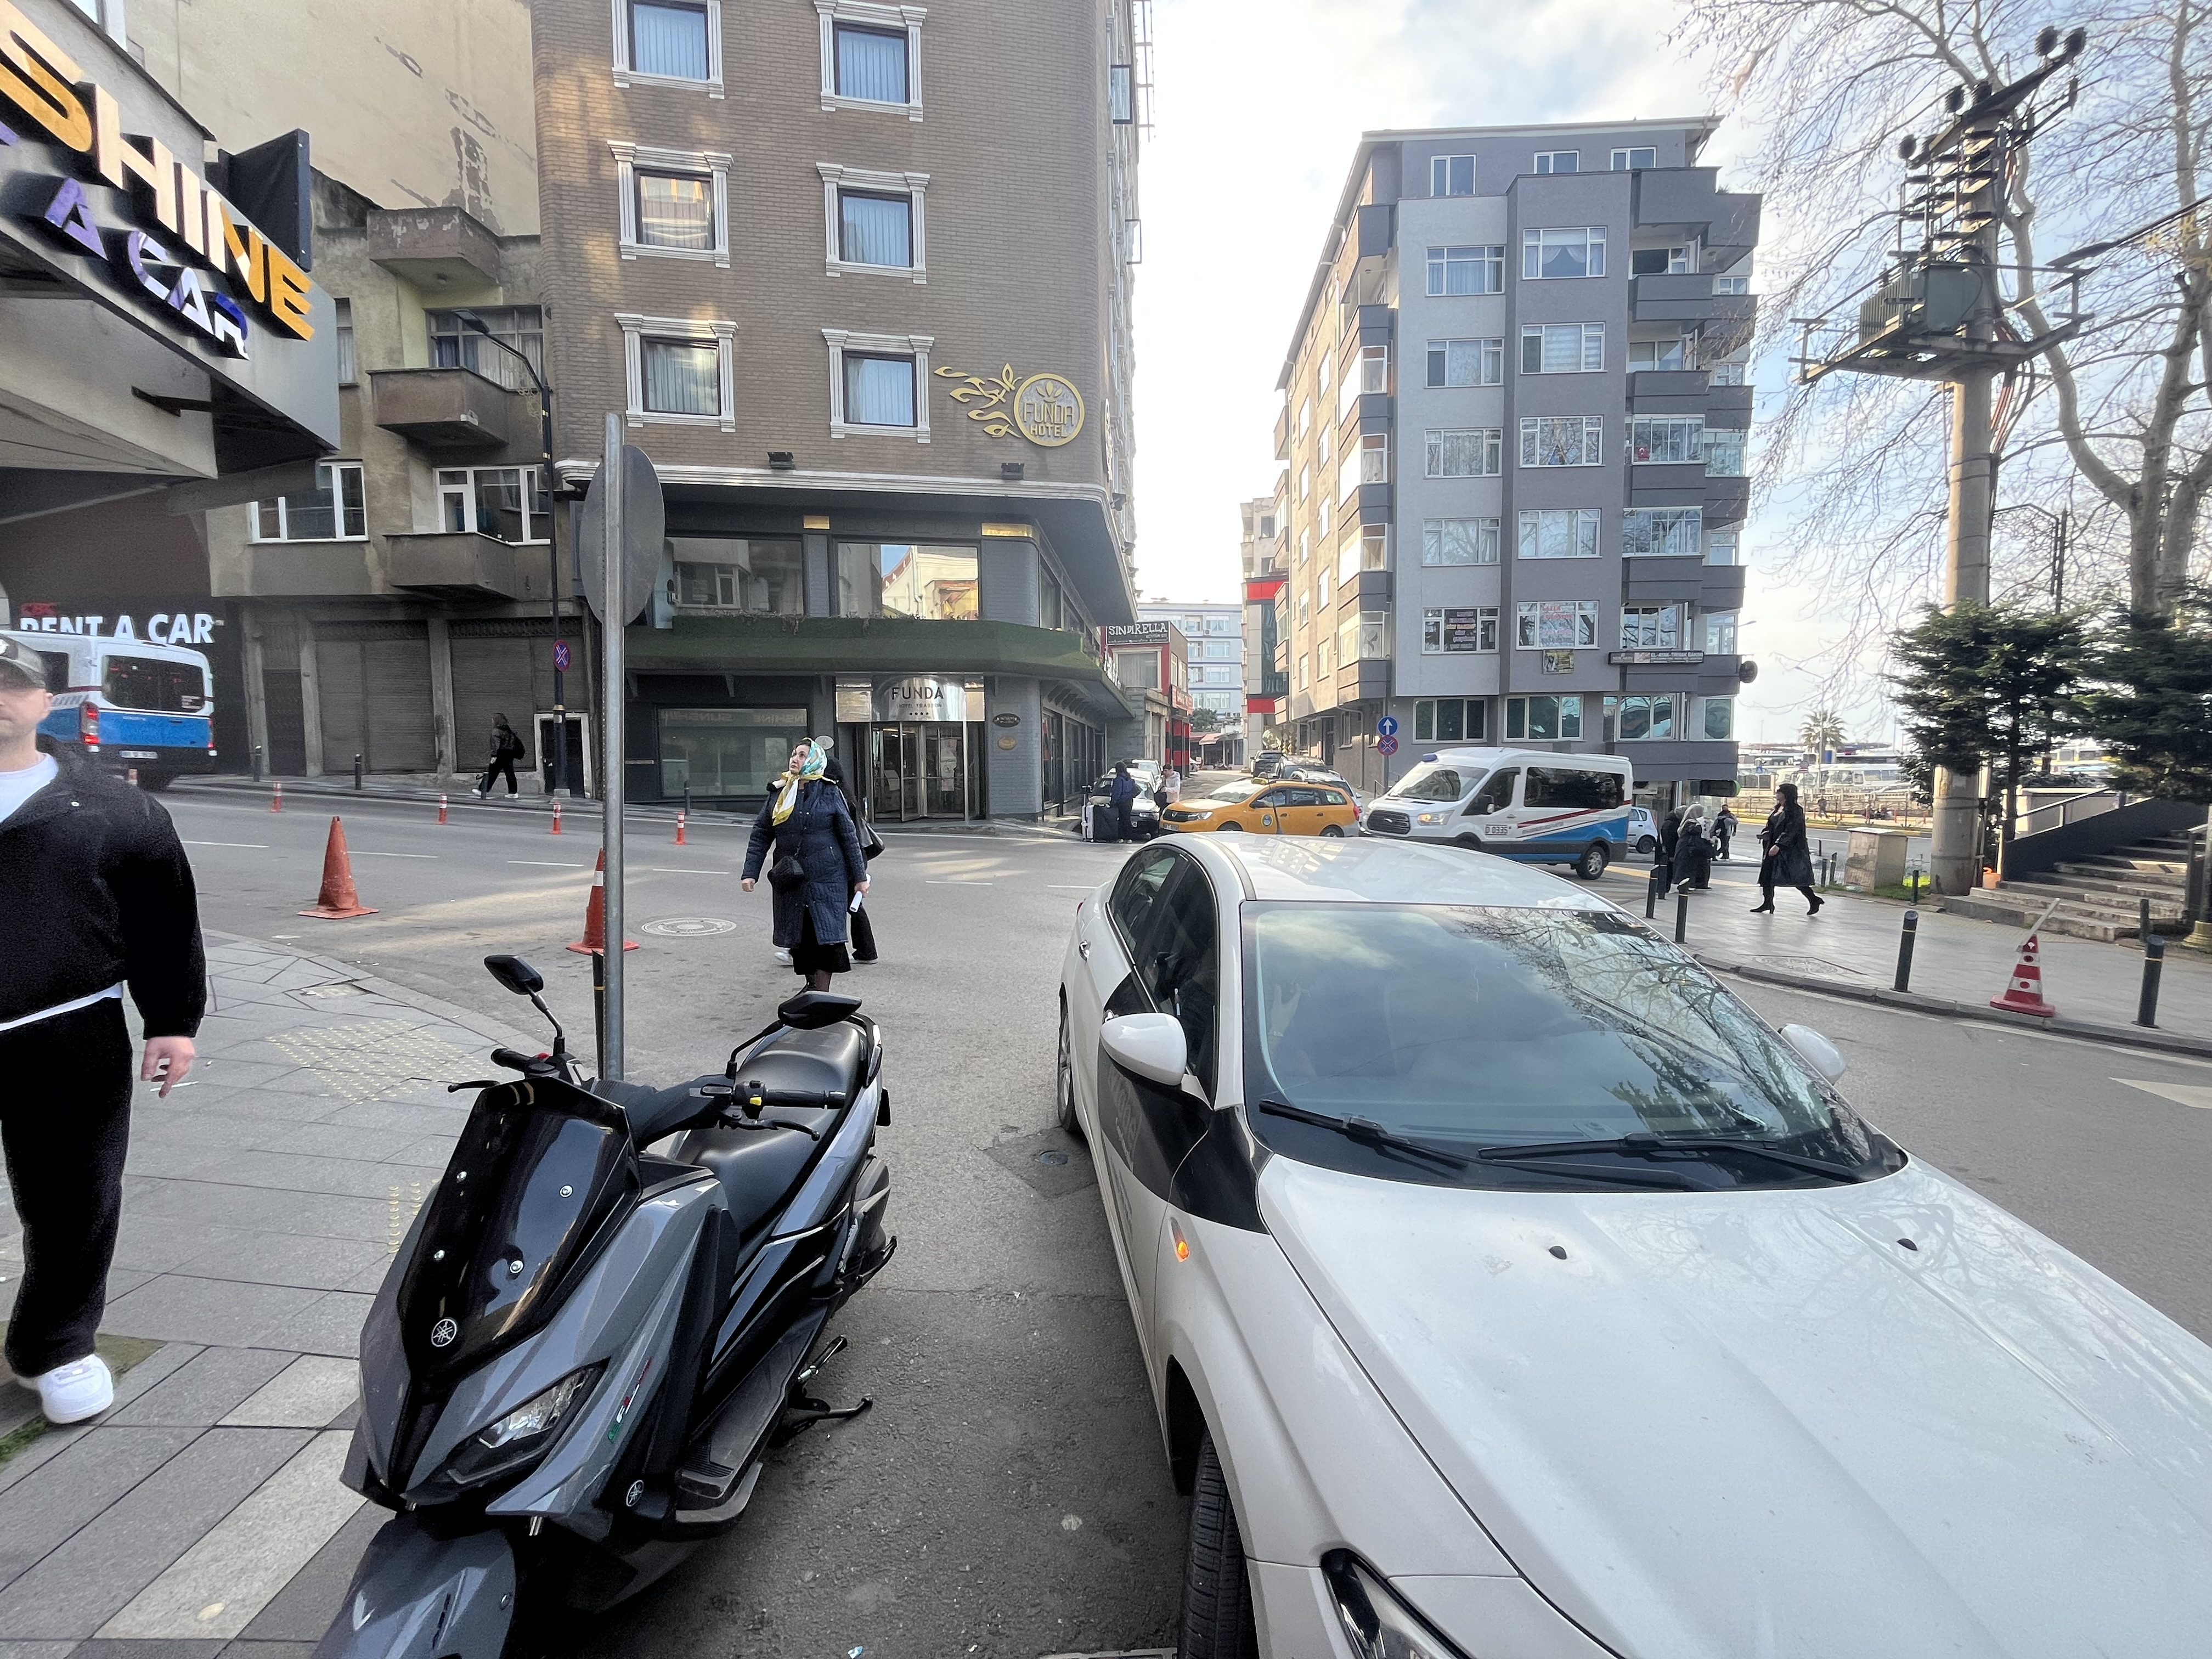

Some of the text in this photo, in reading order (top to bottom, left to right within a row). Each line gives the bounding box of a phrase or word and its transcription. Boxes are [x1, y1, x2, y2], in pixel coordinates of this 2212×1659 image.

[44, 177, 250, 360] A CAR
[1024, 402, 1074, 426] FUNDA
[1030, 424, 1068, 438] HOTEL
[114, 615, 138, 640] A
[148, 613, 215, 644] CAR
[892, 686, 944, 699] FUNDA
